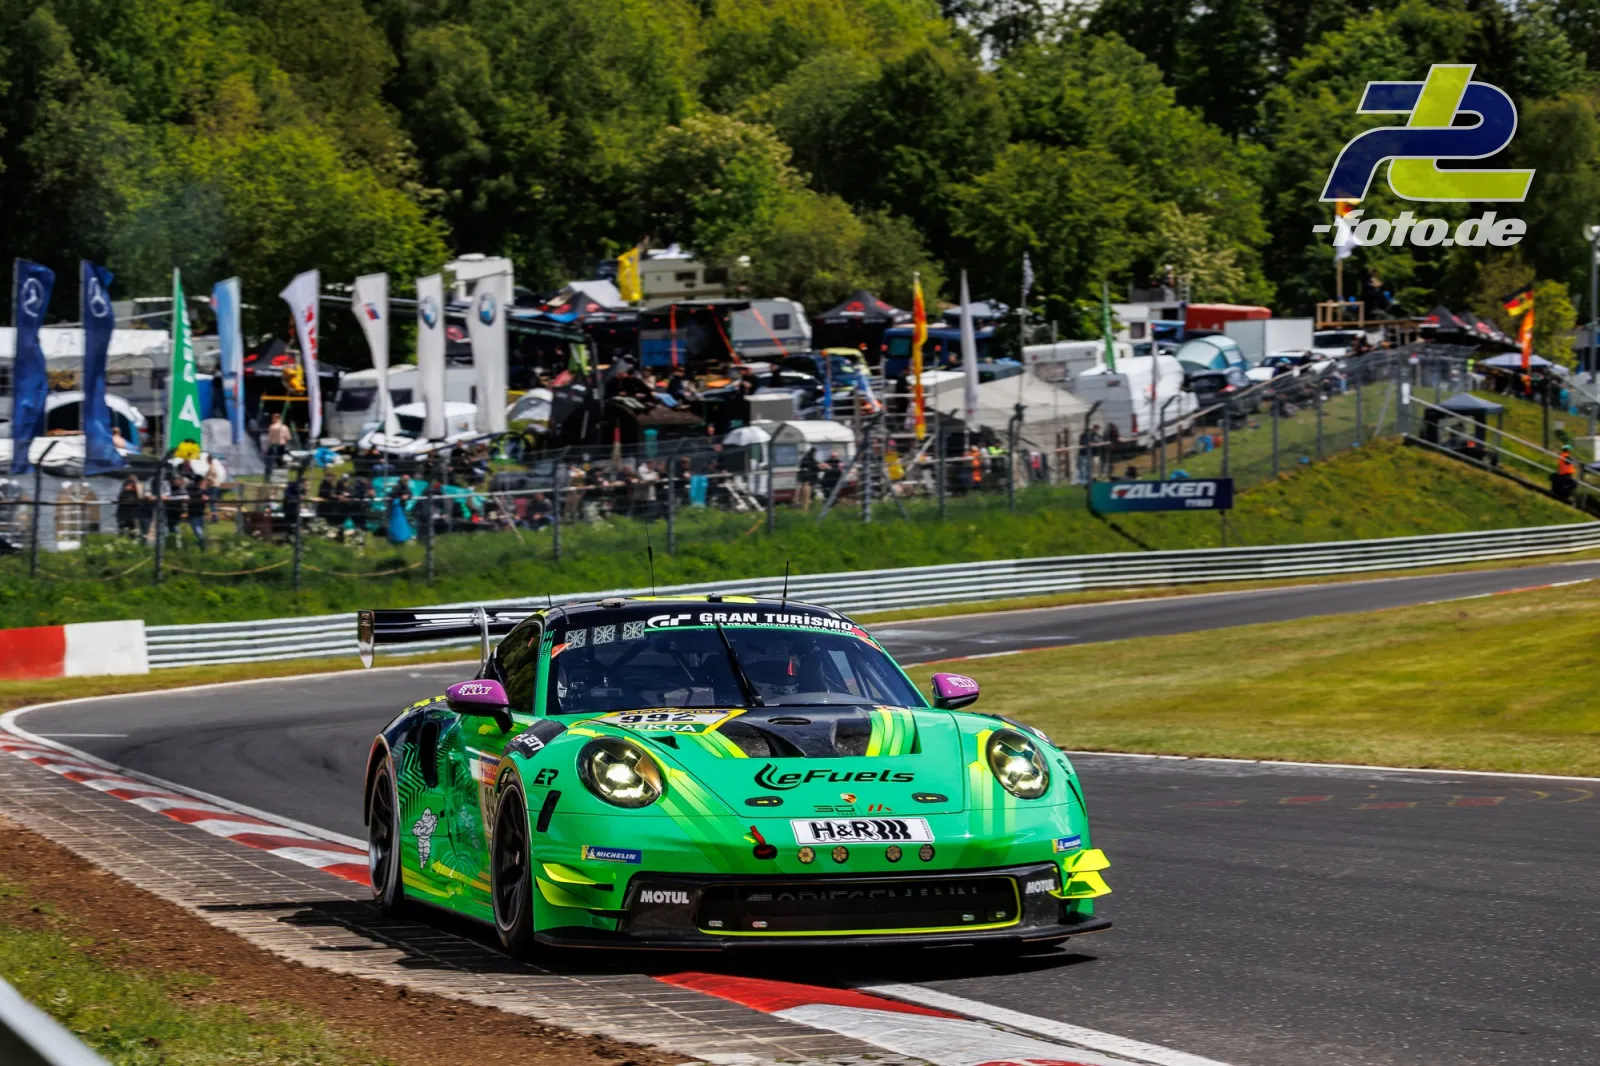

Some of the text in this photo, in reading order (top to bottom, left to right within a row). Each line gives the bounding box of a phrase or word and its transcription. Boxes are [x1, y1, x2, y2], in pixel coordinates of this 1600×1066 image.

[1111, 482, 1217, 499] FALKEN
[700, 612, 757, 623] GRAN
[620, 712, 696, 724] 992
[777, 769, 915, 785] eFuels
[596, 851, 636, 860] MICHELIN
[1025, 878, 1055, 894] MOTUL
[640, 890, 689, 904] MOTUL
